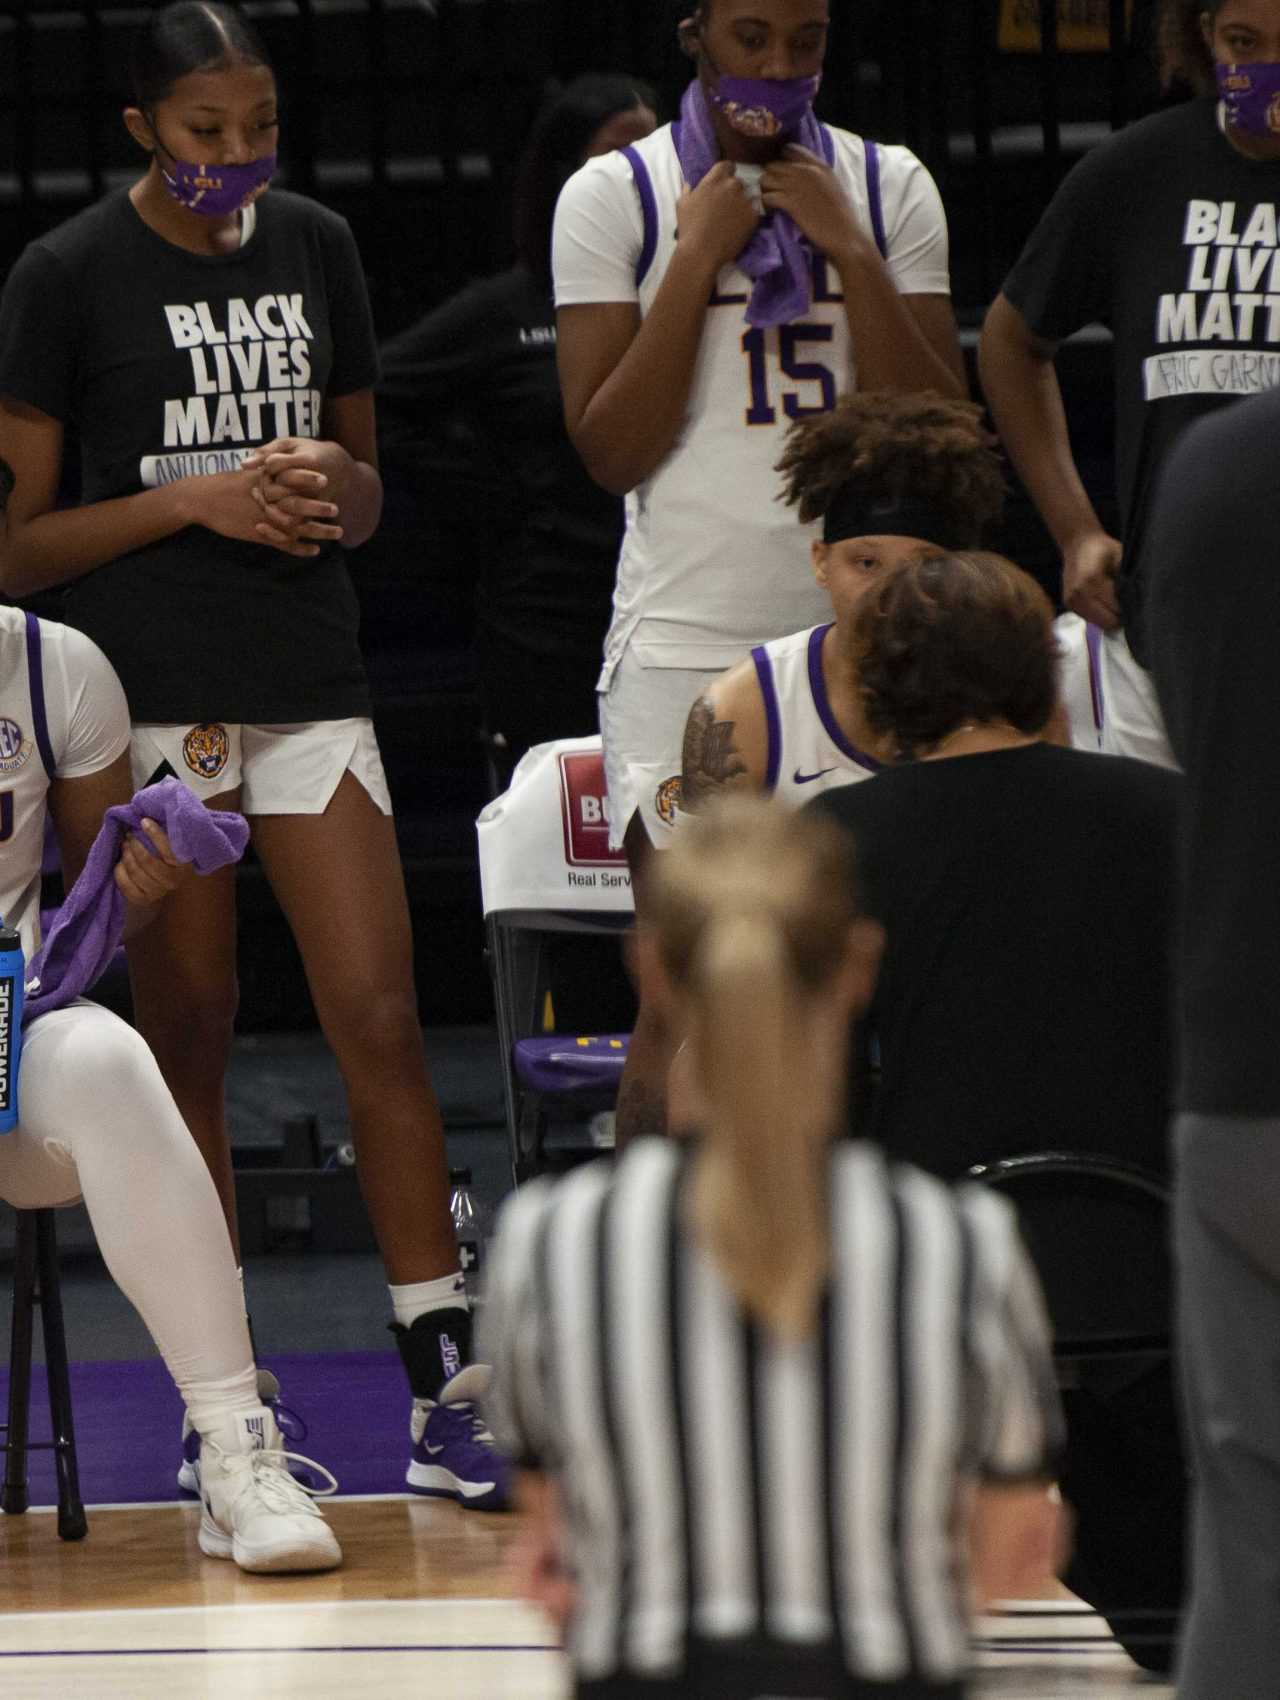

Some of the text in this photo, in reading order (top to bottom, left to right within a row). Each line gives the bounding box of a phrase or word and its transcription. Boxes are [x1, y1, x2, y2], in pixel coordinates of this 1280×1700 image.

[1183, 199, 1280, 247] BLA
[163, 293, 314, 348] BLACK
[188, 338, 313, 395] LIVES
[740, 323, 838, 427] 15
[1210, 353, 1280, 391] GARN
[567, 871, 597, 887] Real
